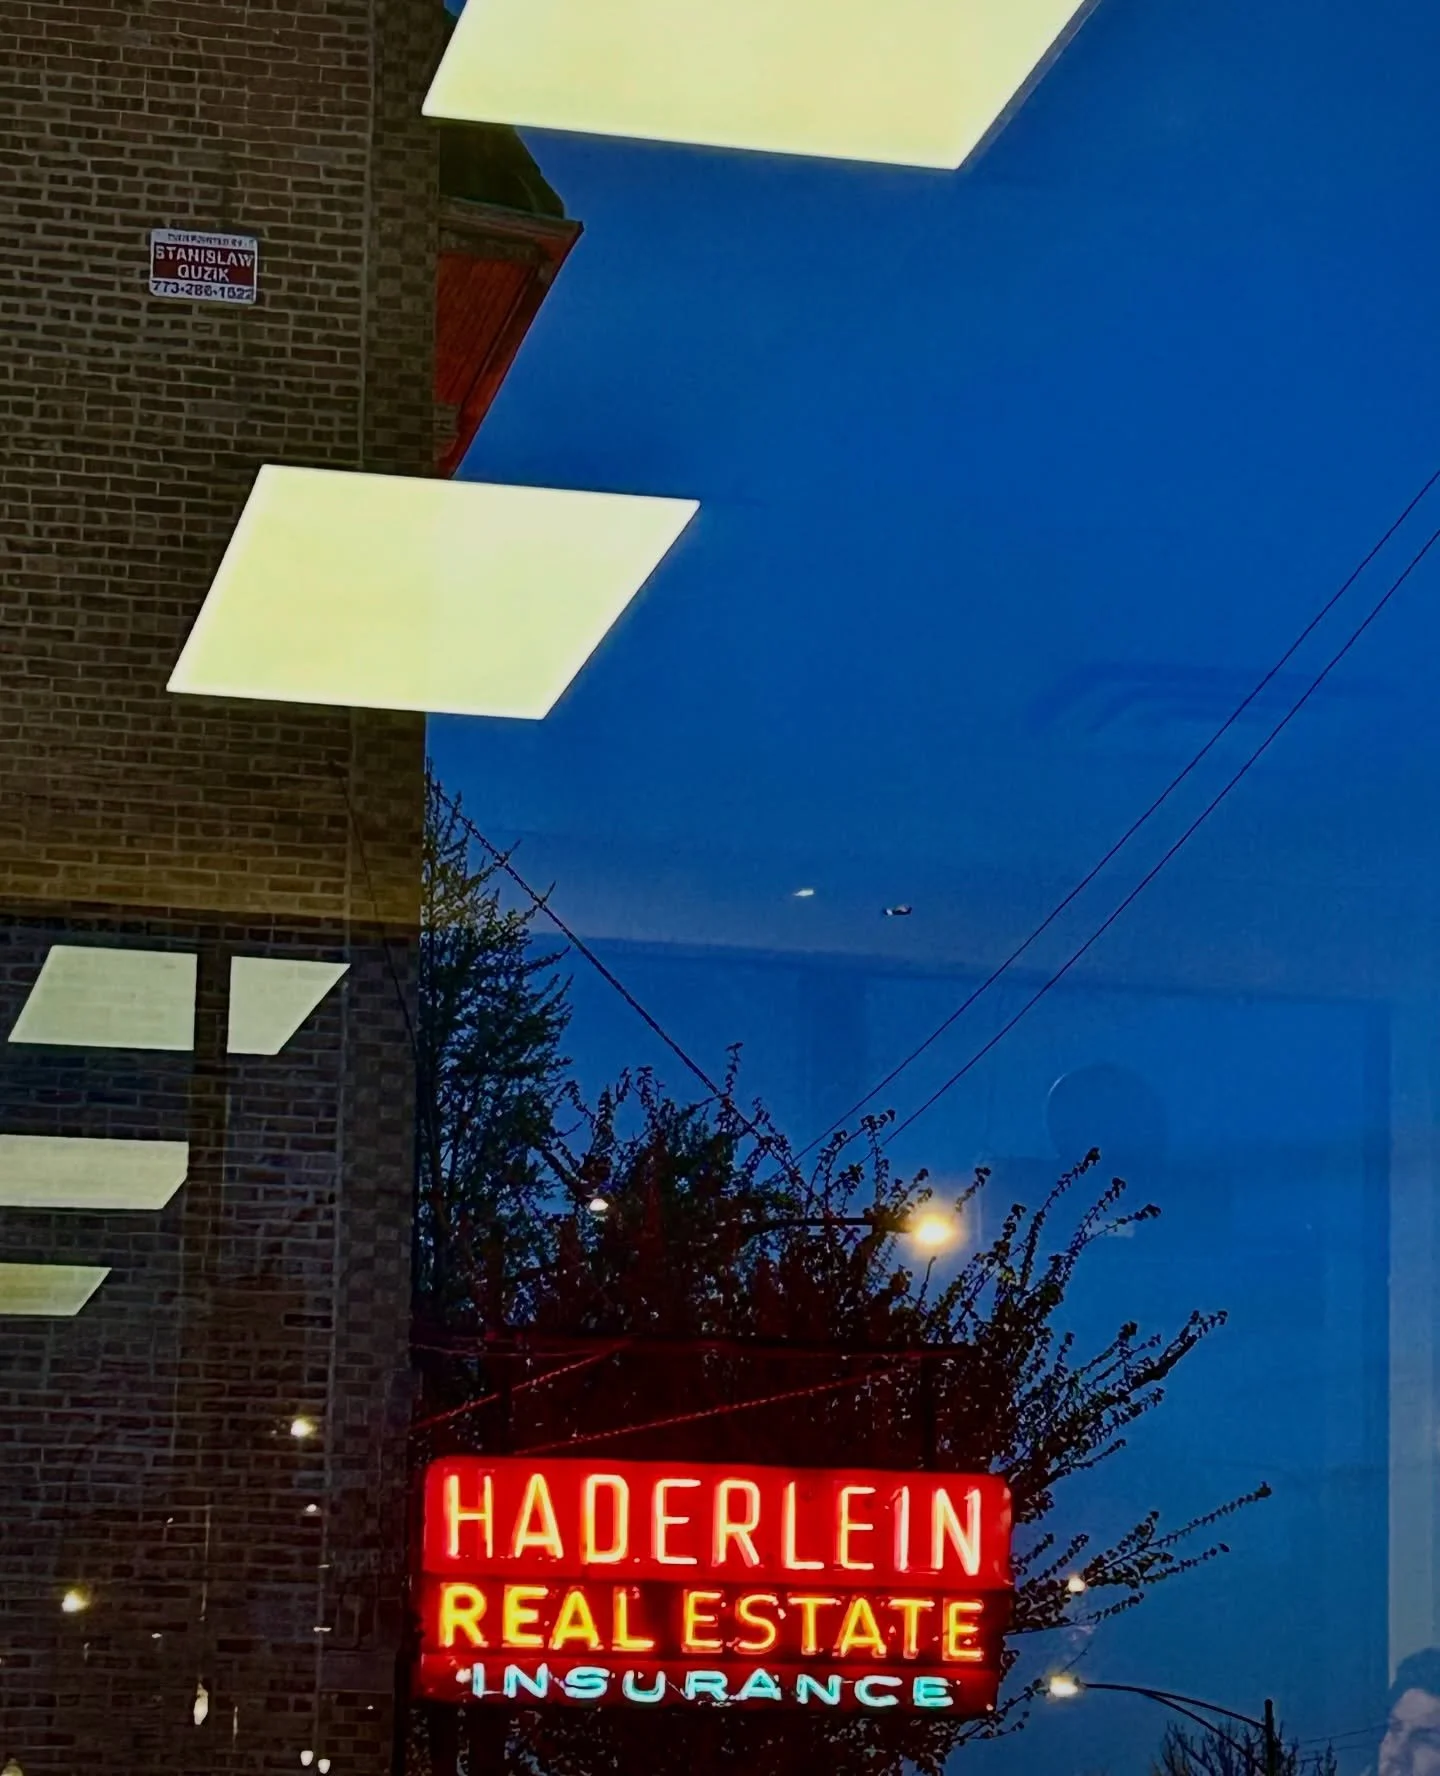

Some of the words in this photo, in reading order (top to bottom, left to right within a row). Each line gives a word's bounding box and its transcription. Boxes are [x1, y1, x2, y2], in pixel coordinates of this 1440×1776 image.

[155, 245, 254, 267] STANISLAW
[444, 1473, 983, 1577] HADERLEIN
[438, 1582, 656, 1652] REAL
[680, 1591, 984, 1661] ESTATE
[470, 1662, 956, 1707] INSURANCE
